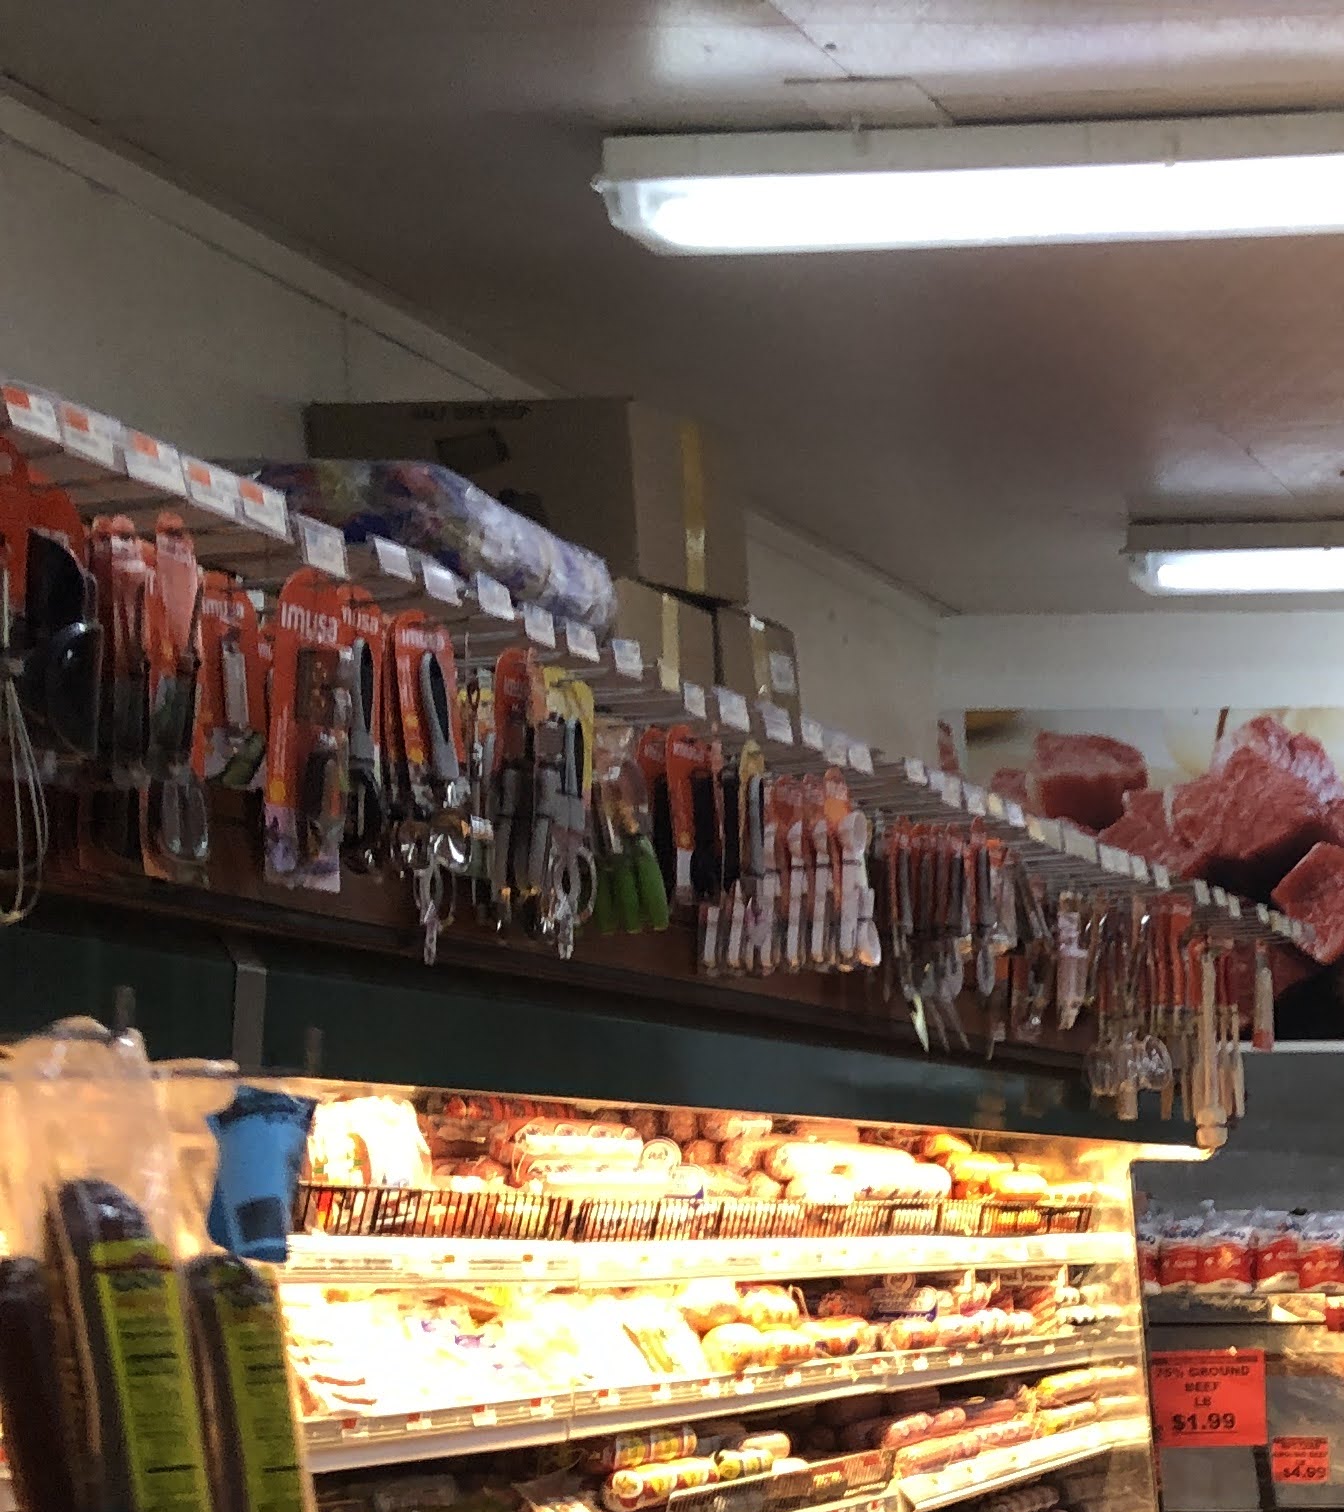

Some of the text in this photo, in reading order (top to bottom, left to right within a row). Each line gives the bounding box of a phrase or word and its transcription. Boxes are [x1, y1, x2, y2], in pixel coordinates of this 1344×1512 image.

[1188, 1365, 1250, 1377] GROUND
[1185, 1381, 1220, 1393] BEEF
[1172, 1412, 1237, 1431] $1.99
